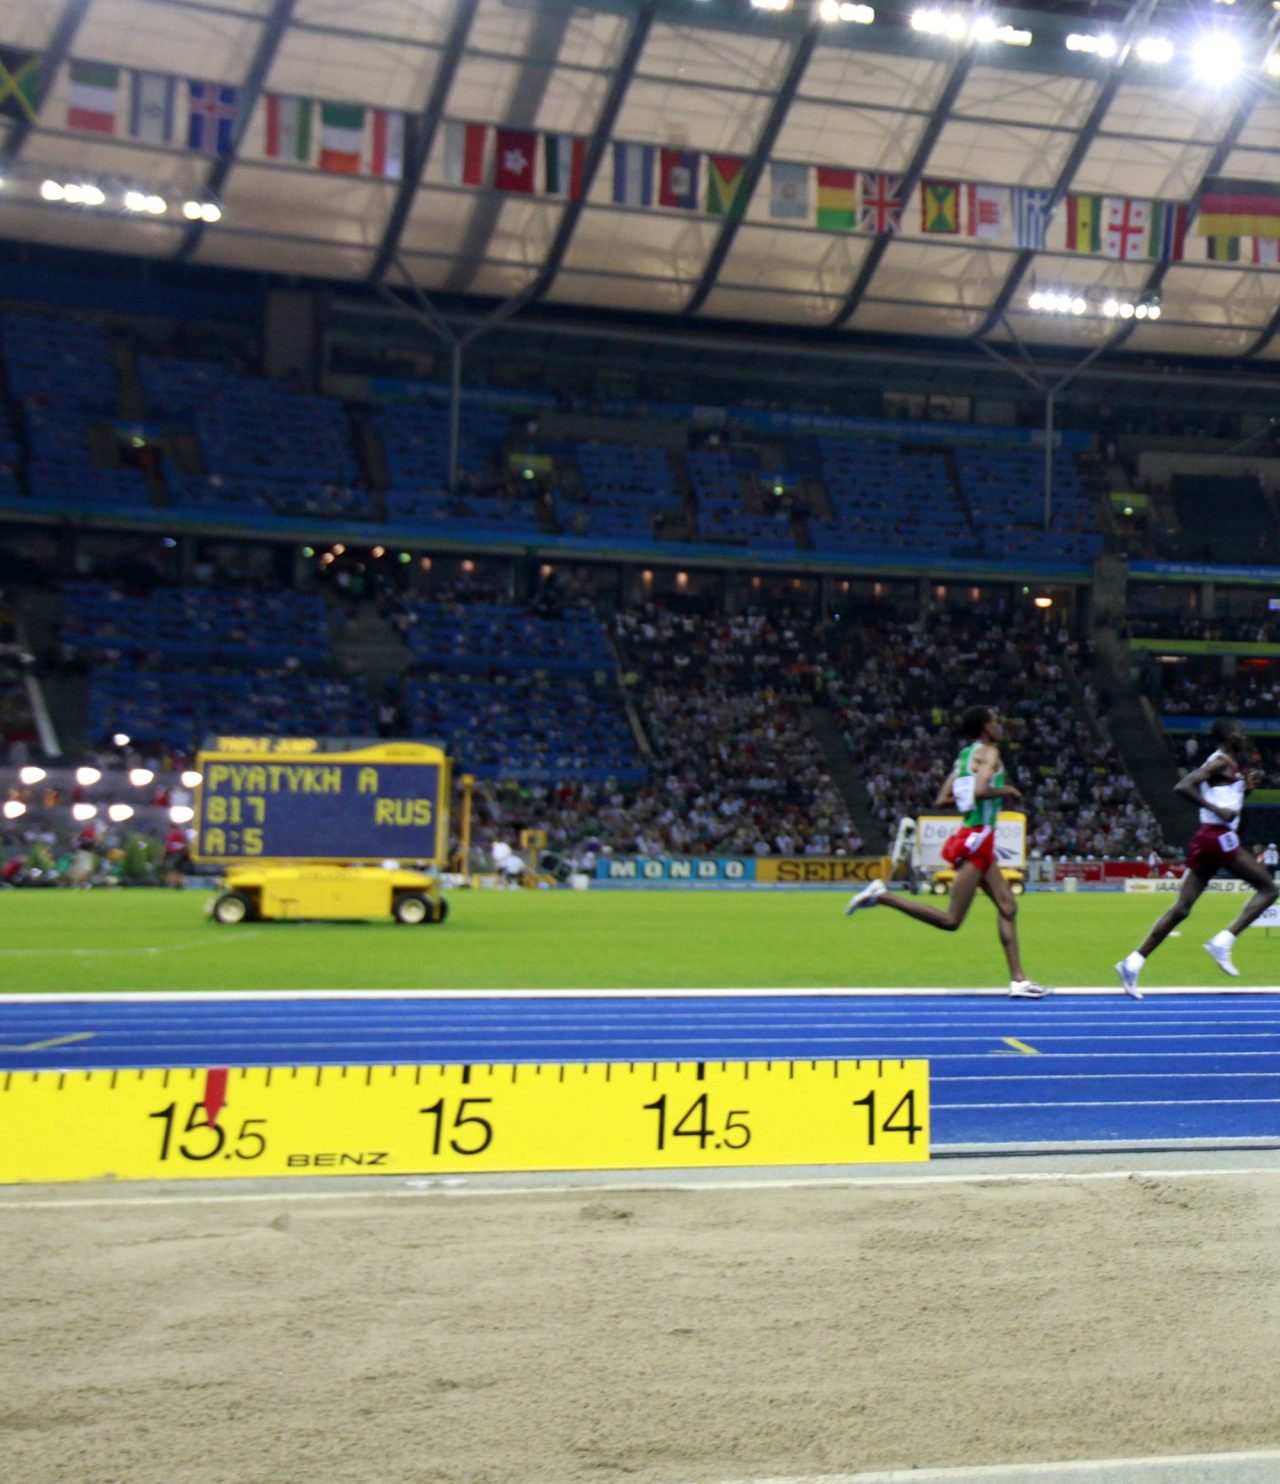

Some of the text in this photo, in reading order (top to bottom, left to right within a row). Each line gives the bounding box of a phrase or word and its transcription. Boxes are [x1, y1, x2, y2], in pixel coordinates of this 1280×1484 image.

[207, 765, 379, 793] PYATYKH A
[206, 796, 432, 825] 817 RUS
[609, 860, 744, 880] MONDO
[777, 861, 882, 881] SEIKO
[419, 1097, 493, 1156] 15
[643, 1093, 752, 1151] 14.5
[852, 1089, 923, 1146] 14
[287, 1153, 391, 1167] BENZ
